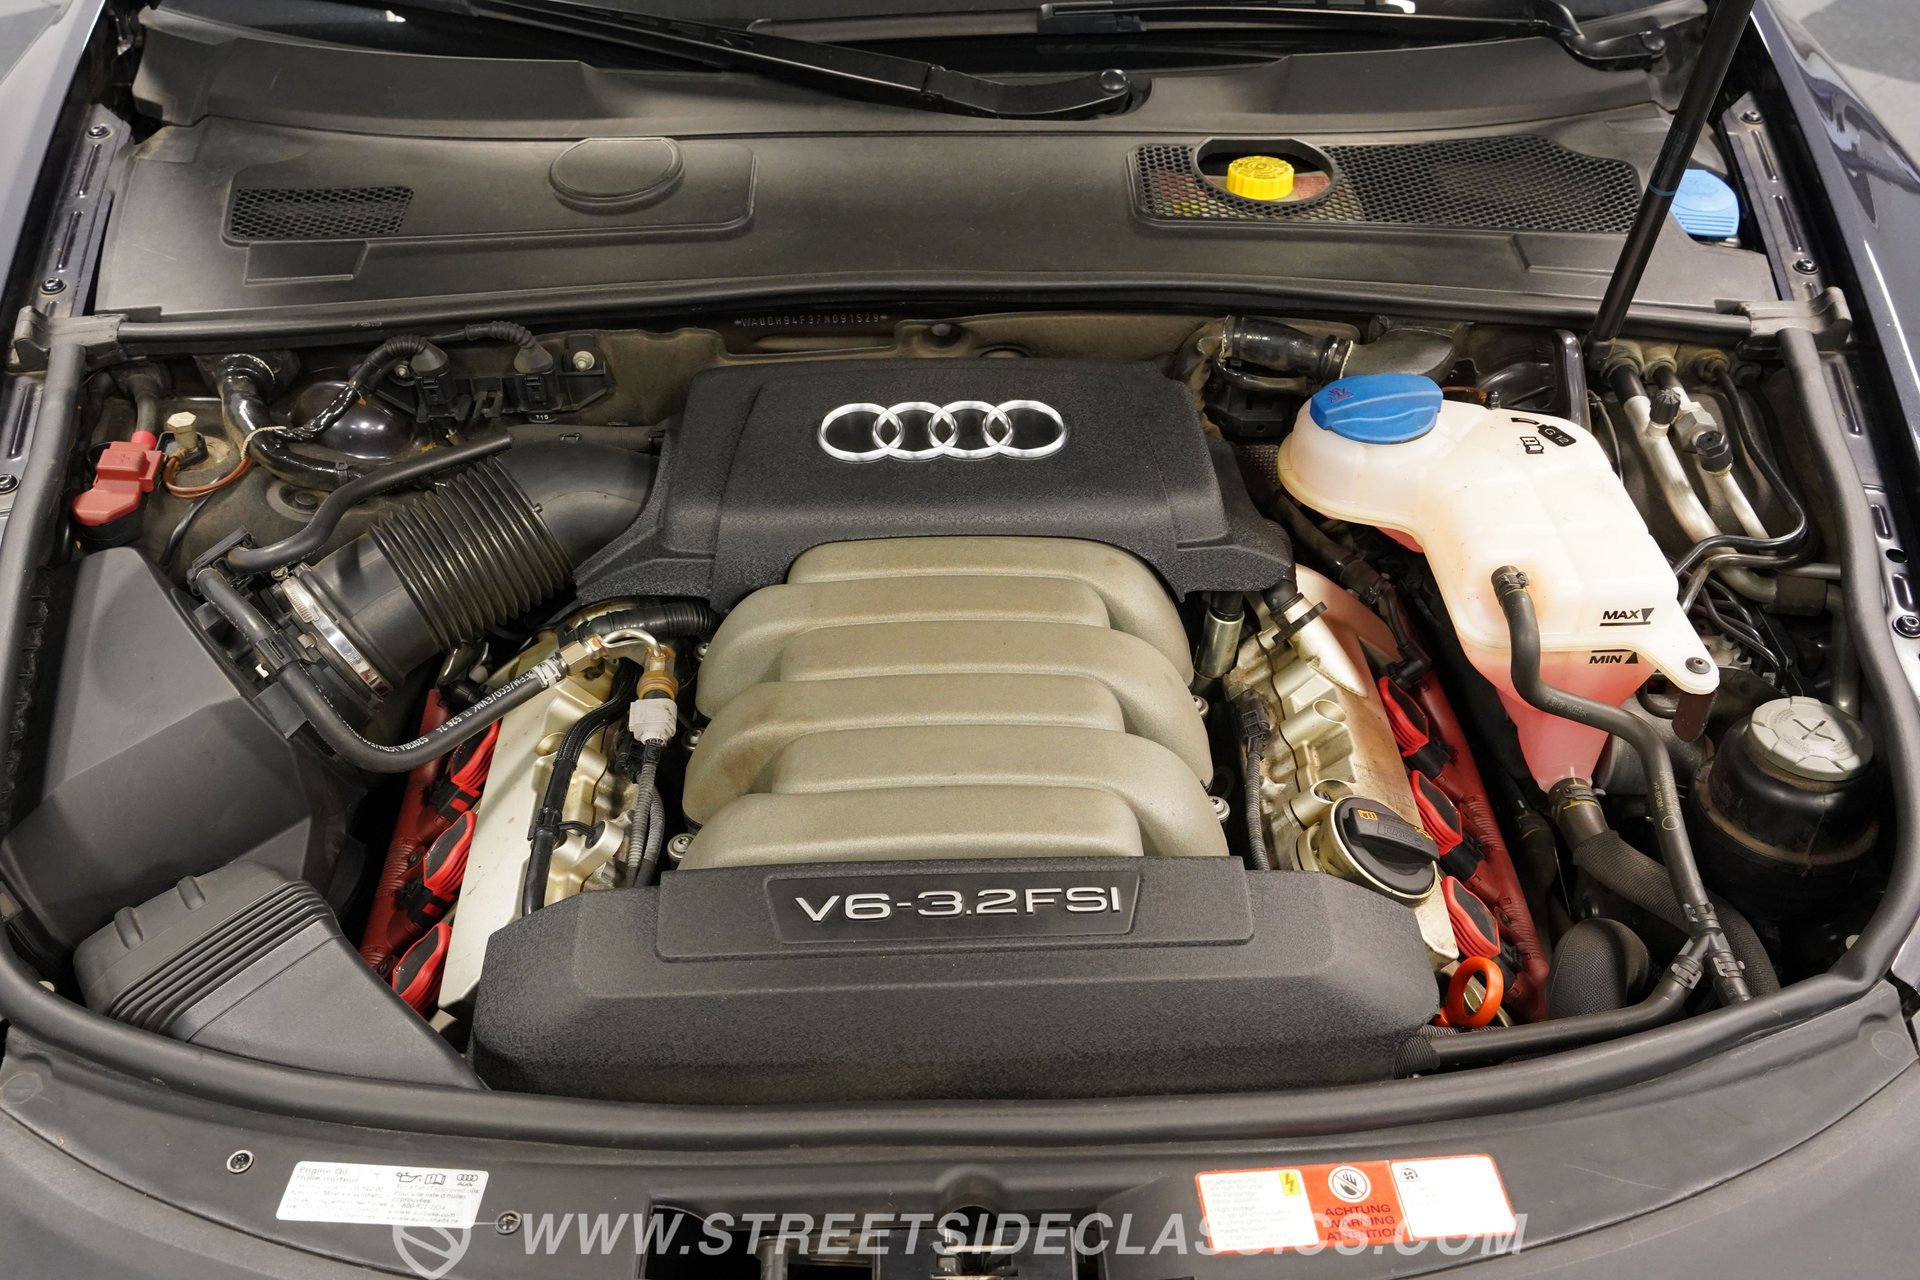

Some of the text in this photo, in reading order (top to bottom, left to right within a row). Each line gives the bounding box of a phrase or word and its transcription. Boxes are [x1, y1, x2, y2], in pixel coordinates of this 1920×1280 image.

[1544, 428, 1570, 444] G 12
[1602, 609, 1640, 620] MAX
[1589, 655, 1622, 664] MIN
[334, 1167, 348, 1175] Oil
[1325, 1204, 1391, 1216] ACHTUNG
[1326, 1215, 1396, 1228] WARNING
[1327, 1228, 1402, 1240] ATTENTION
